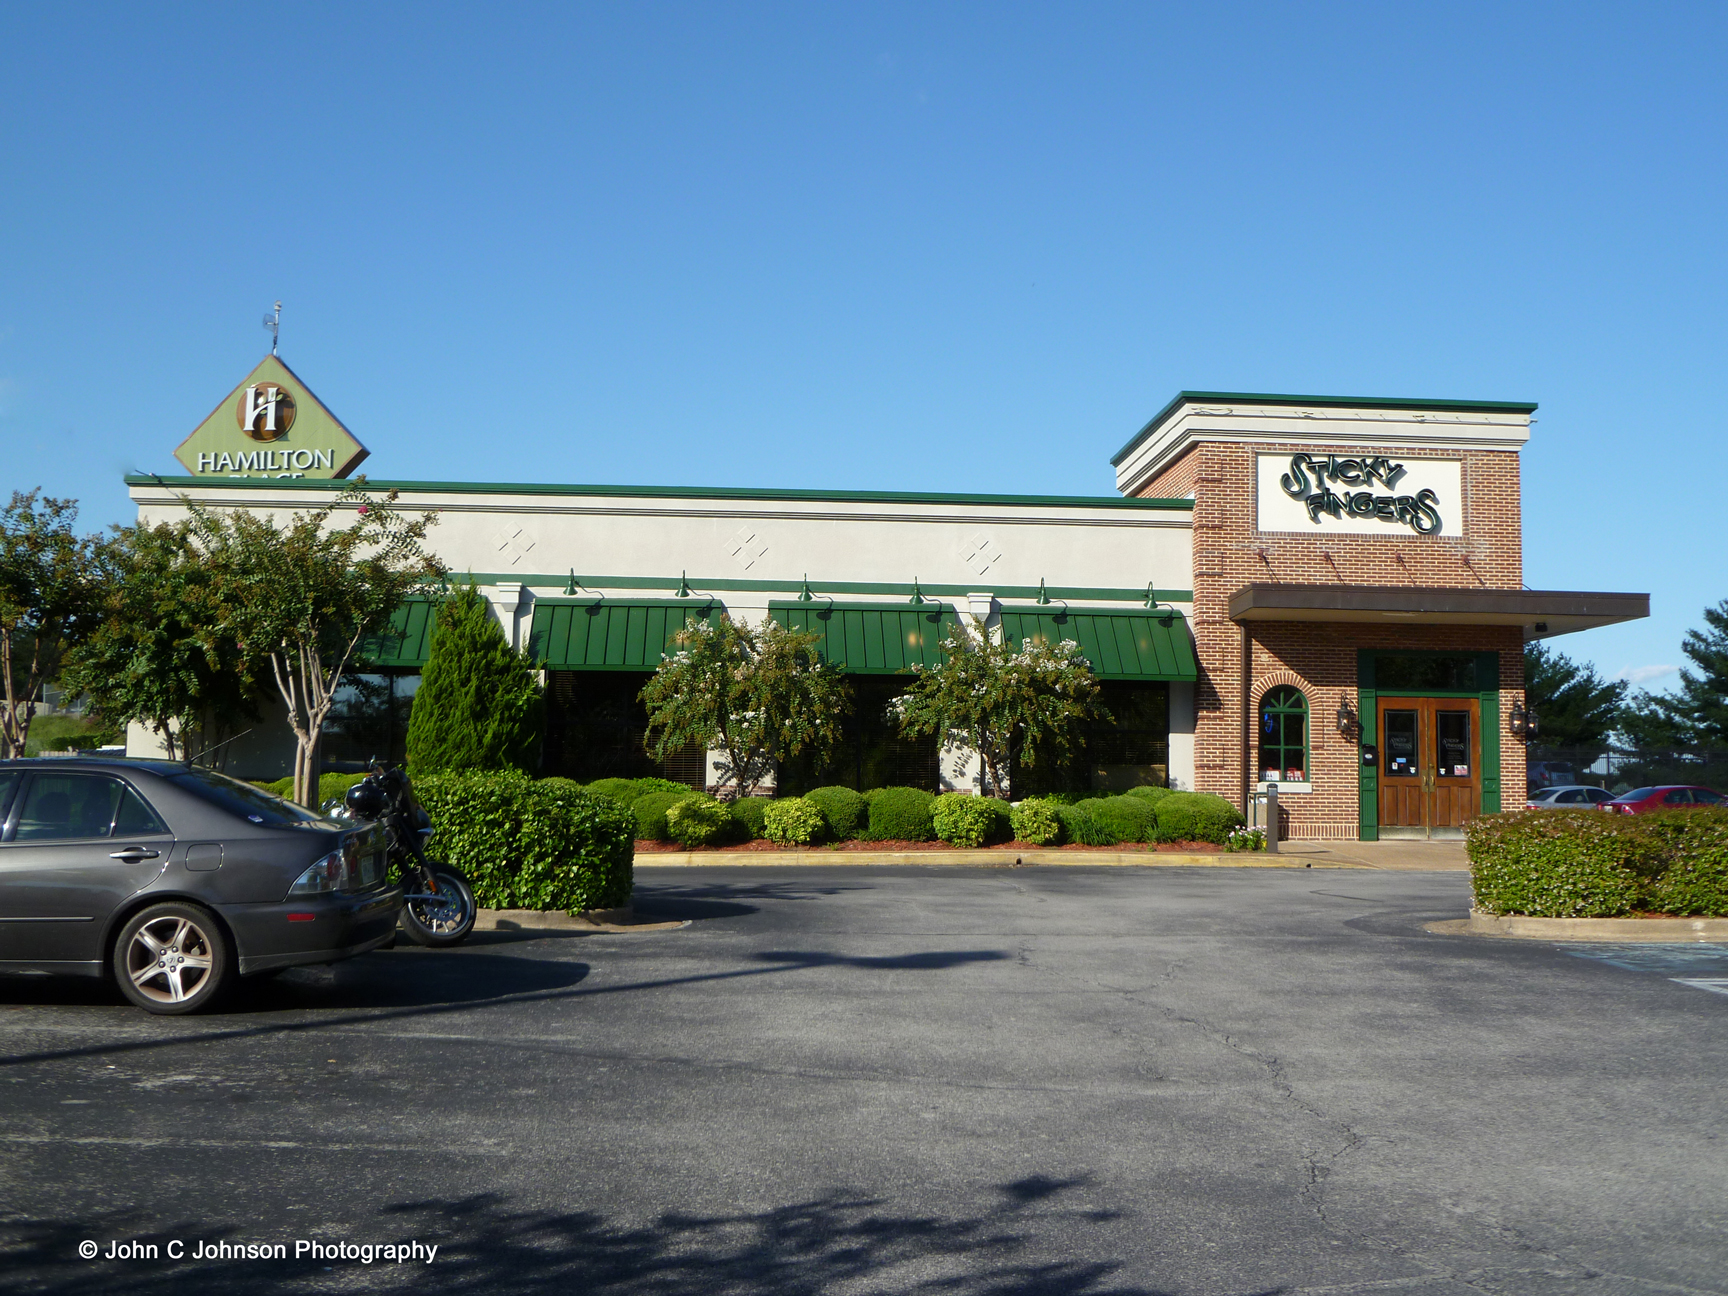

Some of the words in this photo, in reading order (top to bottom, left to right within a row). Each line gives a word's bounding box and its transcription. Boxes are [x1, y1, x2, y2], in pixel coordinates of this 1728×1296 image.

[198, 449, 334, 472] HAMILTON
[1280, 453, 1403, 495] STICKY
[1305, 488, 1440, 534] FINGERS
